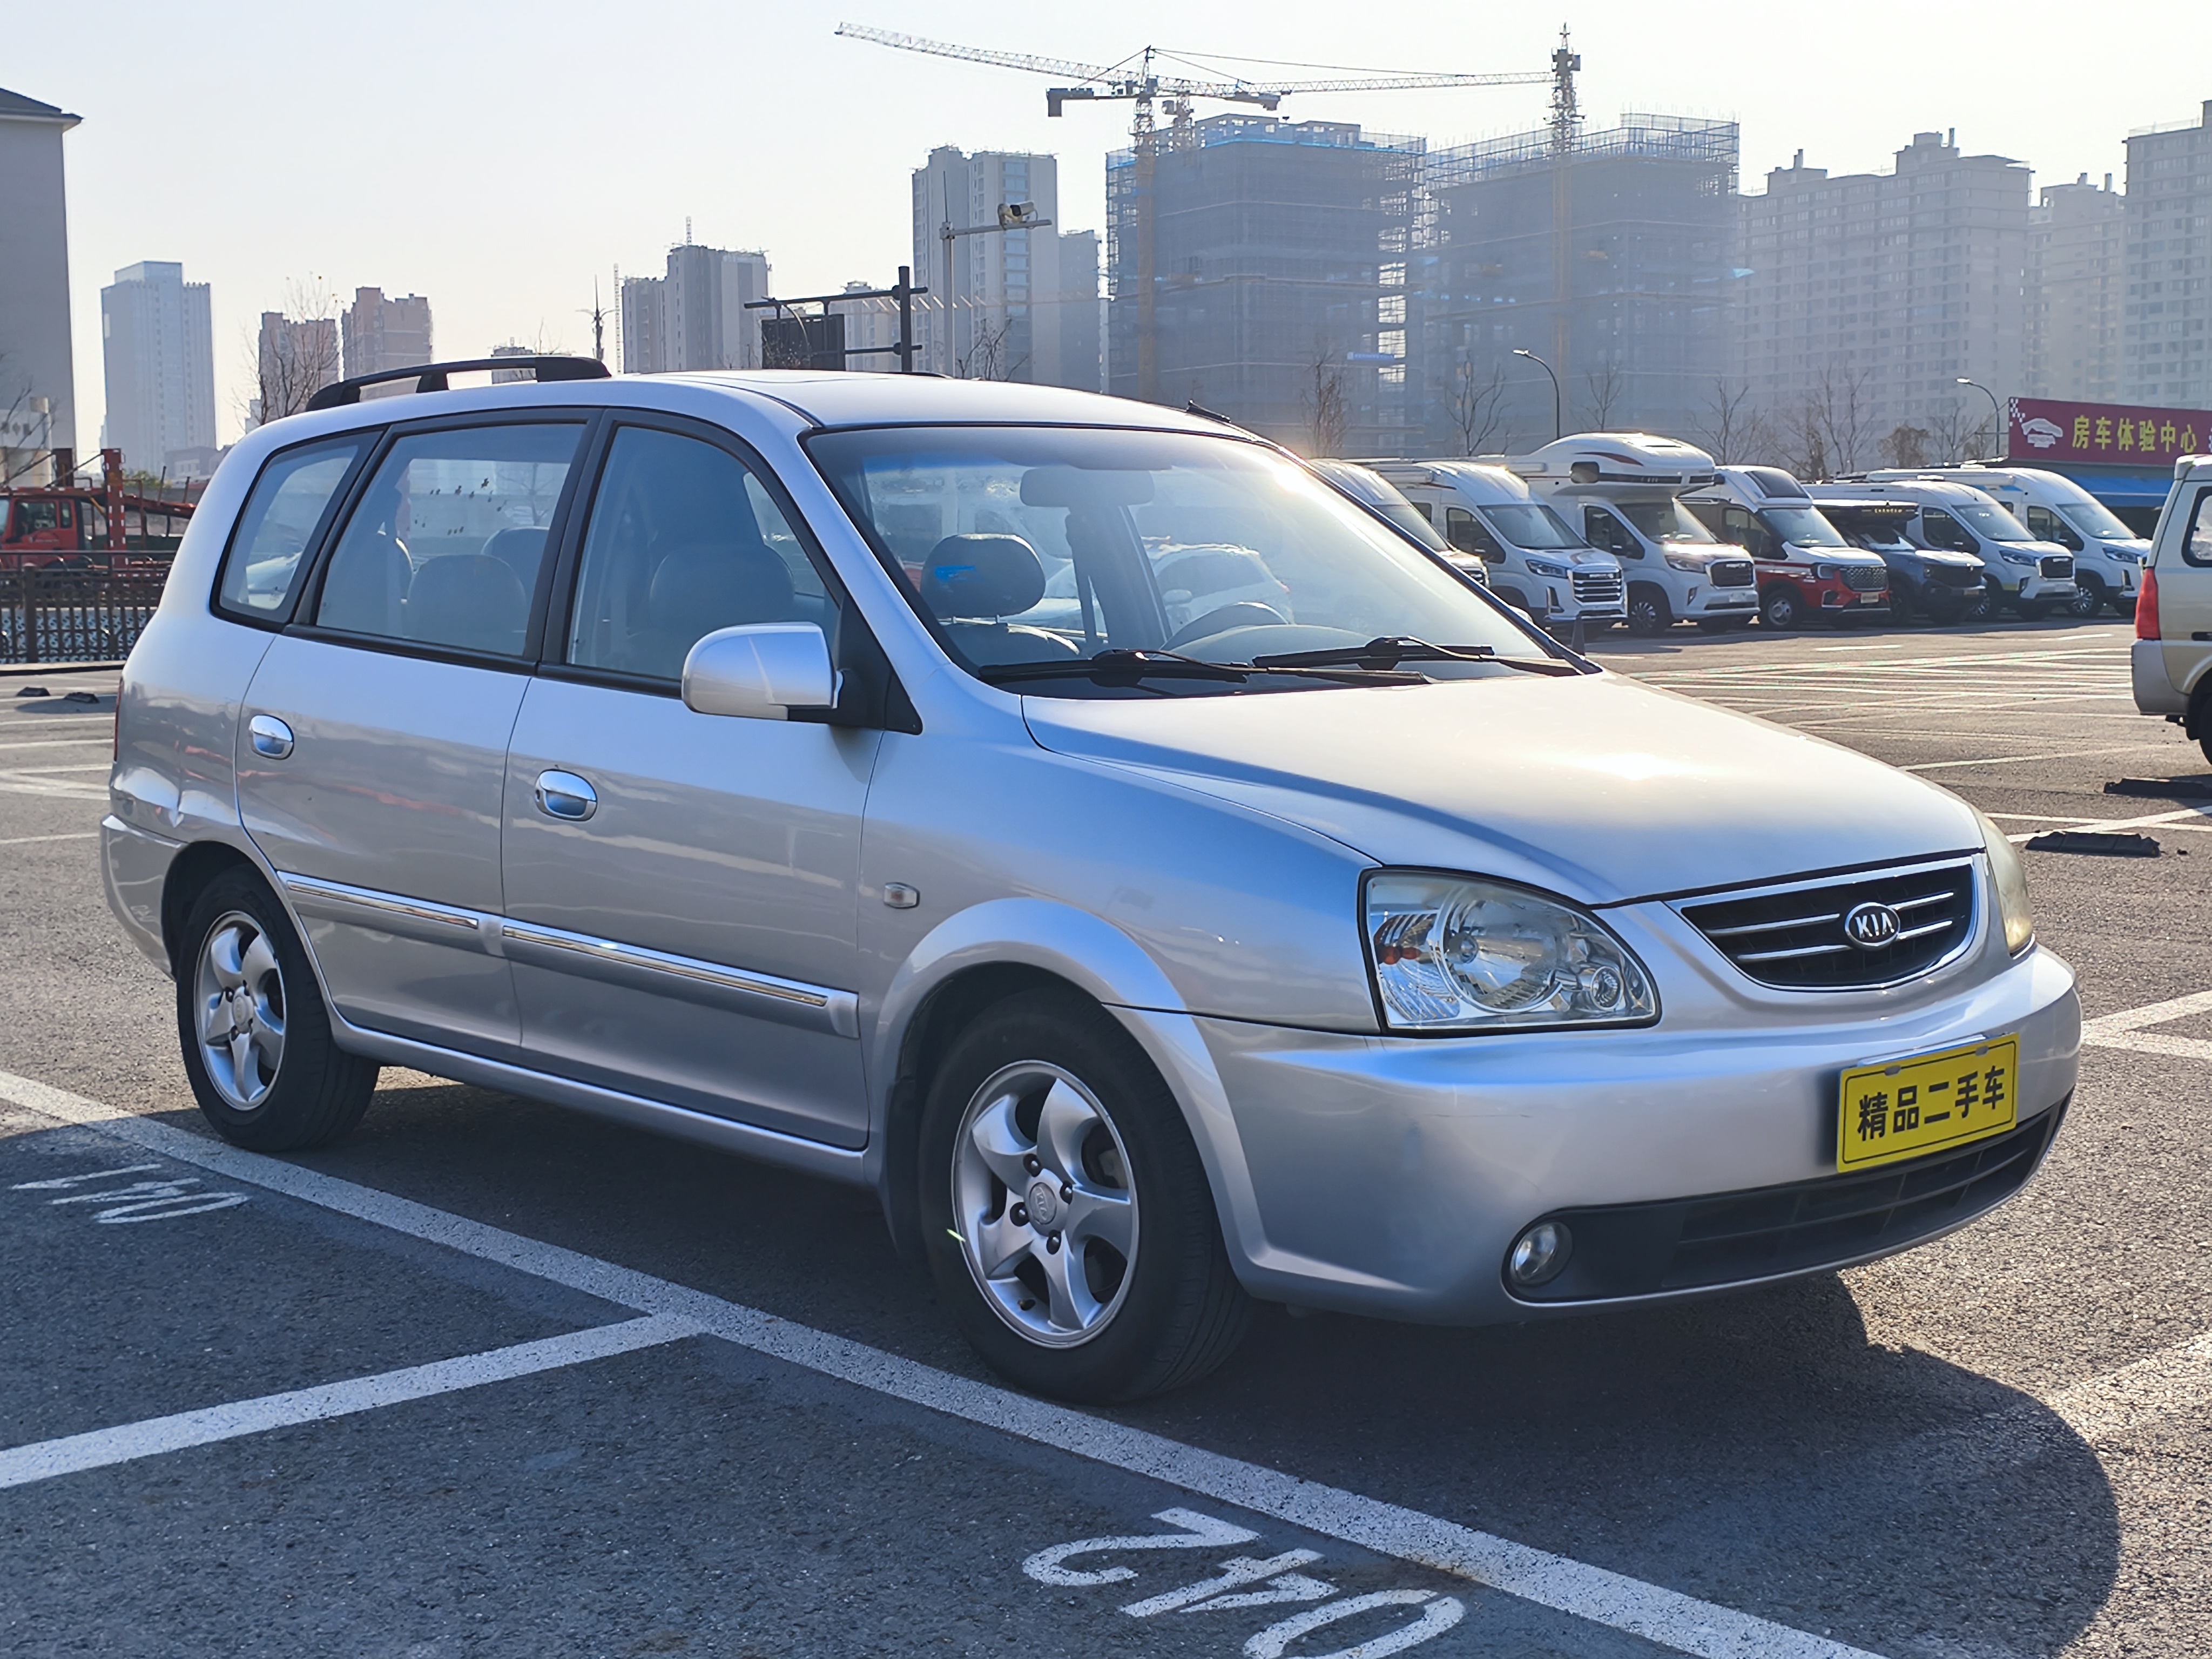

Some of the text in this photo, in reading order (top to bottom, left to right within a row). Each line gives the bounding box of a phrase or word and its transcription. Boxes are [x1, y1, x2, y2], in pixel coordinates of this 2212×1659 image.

[2072, 414, 2197, 453] 房车体验中心
[1854, 912, 1895, 939] KIA
[1857, 1065, 2005, 1142] 精品二手车
